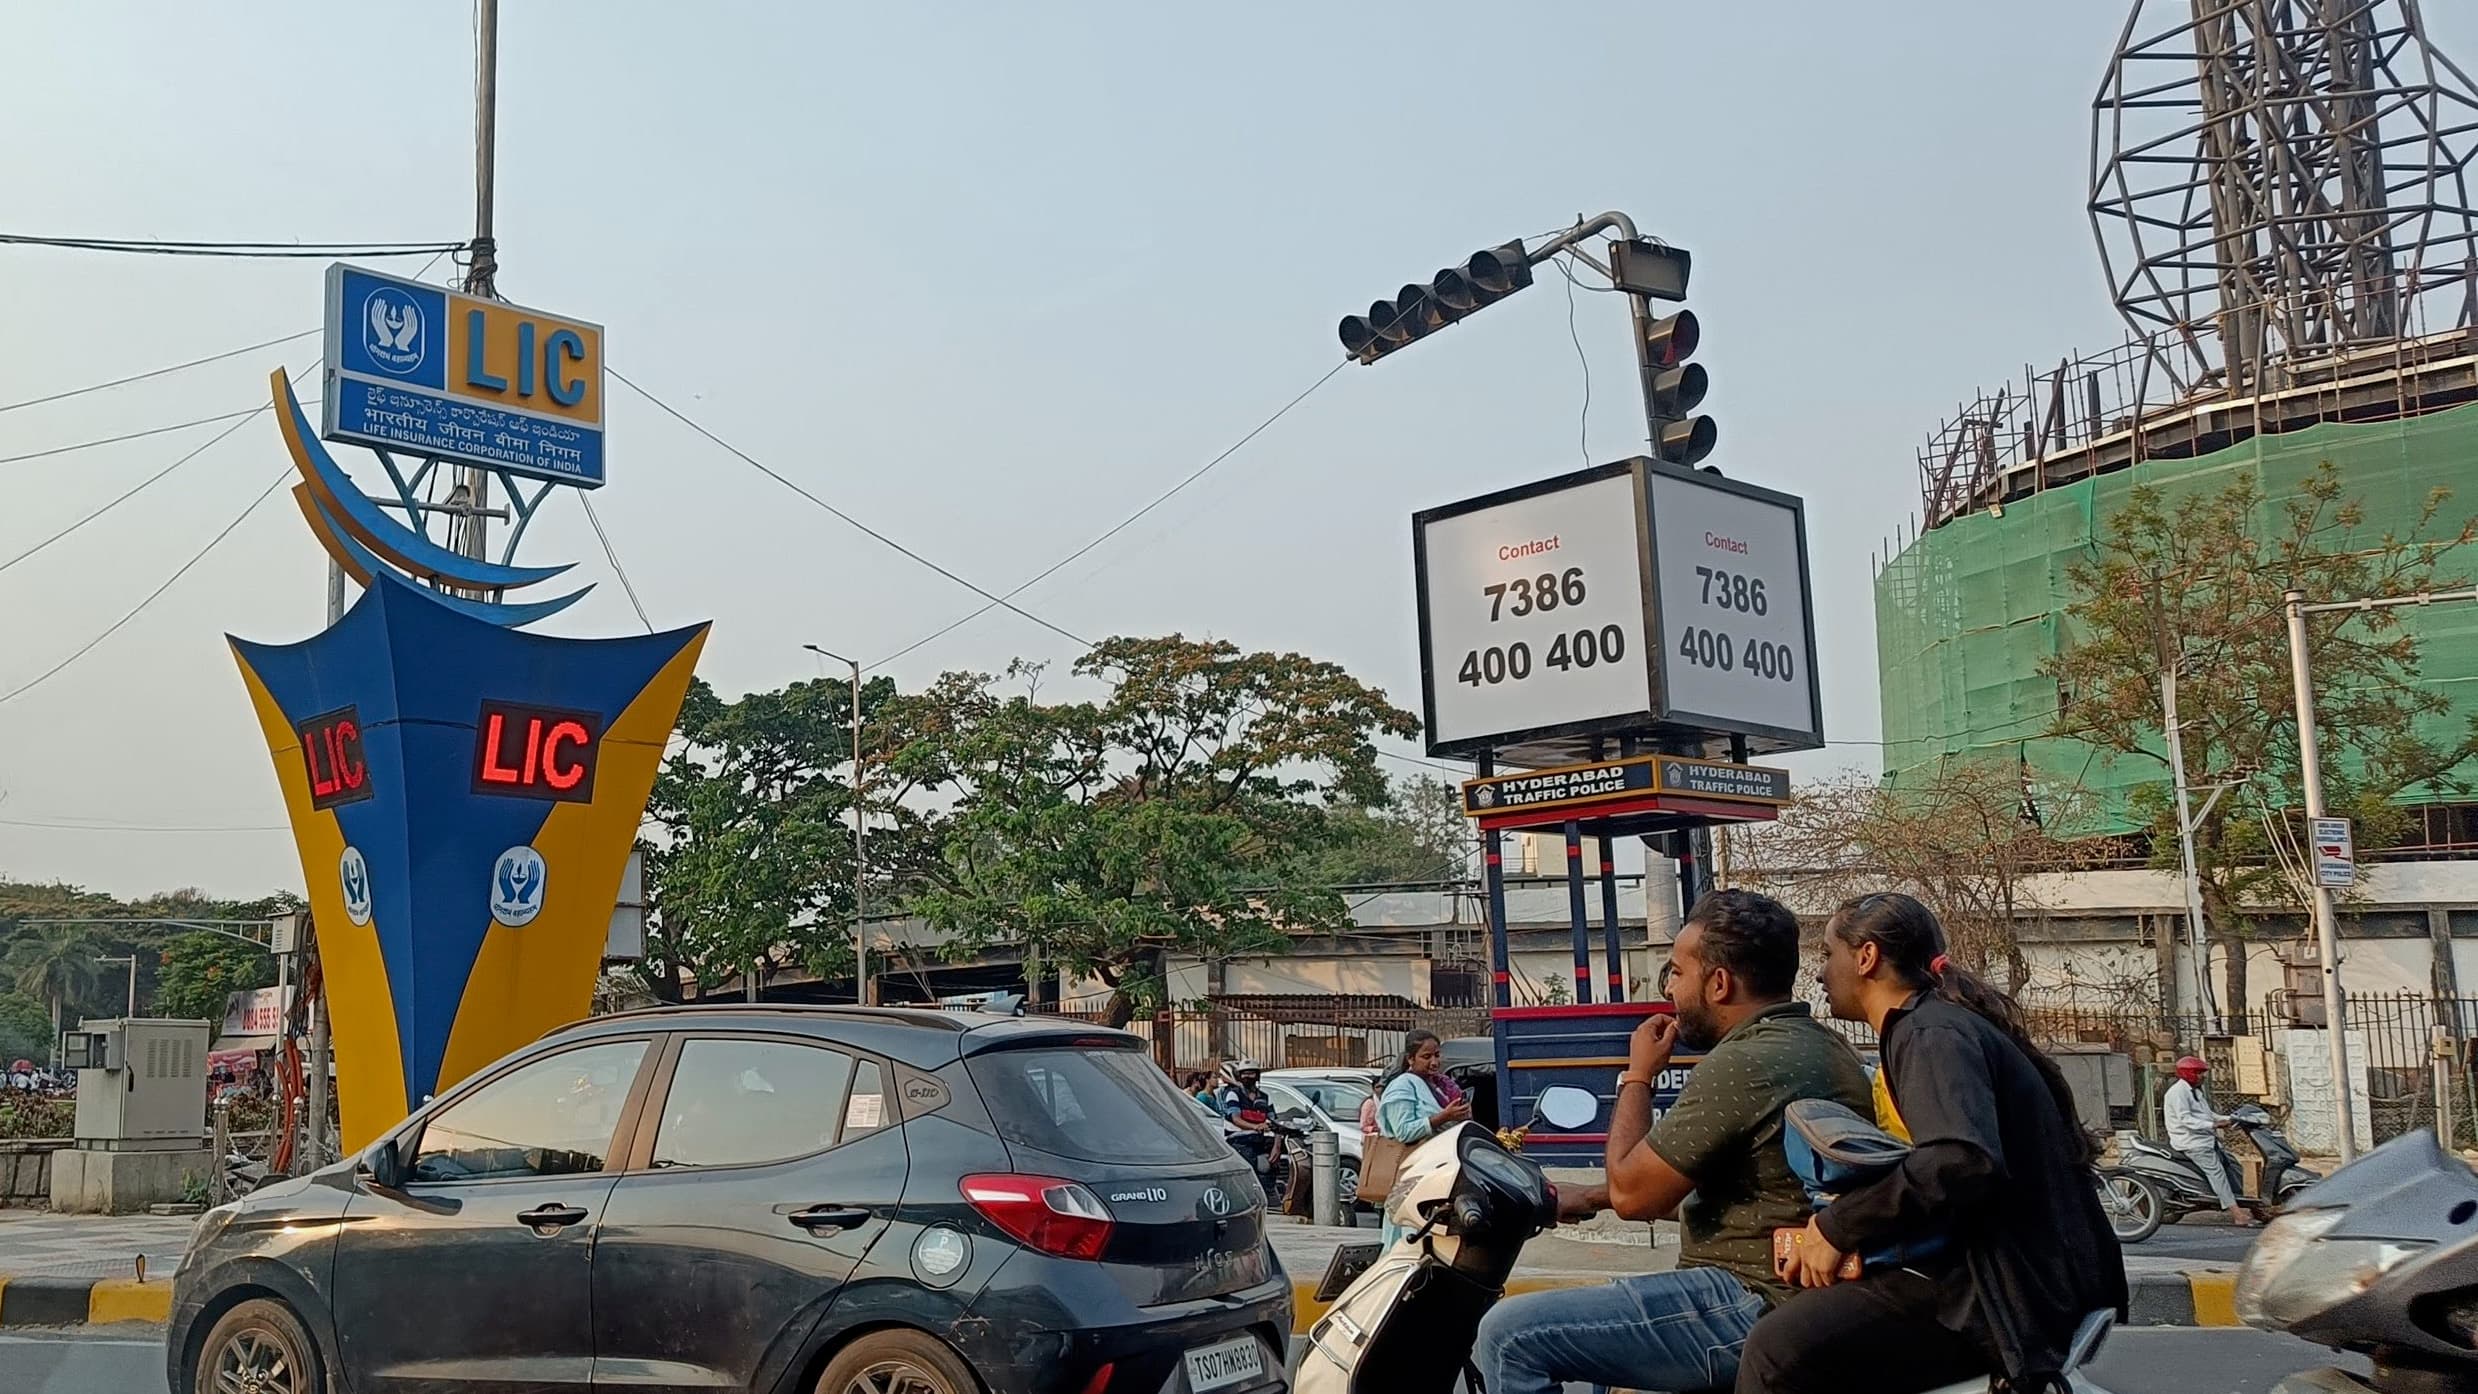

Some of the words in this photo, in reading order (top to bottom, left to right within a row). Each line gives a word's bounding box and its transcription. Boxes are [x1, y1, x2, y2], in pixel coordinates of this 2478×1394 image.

[466, 310, 586, 407] LIC
[363, 422, 388, 436] LIFE
[390, 427, 455, 449] INSURANCE
[458, 441, 534, 465] CORPORATION
[536, 456, 551, 468] OF
[553, 459, 582, 474] INDIA
[364, 408, 428, 432] भारतीय
[437, 421, 486, 443] जीवन
[538, 439, 582, 462] निगम
[1499, 535, 1560, 561] Contact
[1705, 531, 1748, 555] Contact
[1484, 567, 1586, 622] 7386
[1696, 565, 1767, 616] 7386
[1458, 641, 1532, 688] 400
[1546, 623, 1625, 672] 400
[1680, 626, 1733, 672] 400
[1743, 638, 1793, 682] 400
[305, 720, 365, 796] LIC
[482, 714, 588, 789] LIC
[1689, 765, 1771, 784] HYDERABAD
[1502, 766, 1625, 793] HYDERABAD
[1504, 788, 1566, 805] TRAFFIC
[1570, 779, 1625, 797] POLICE
[1690, 780, 1735, 794] TRAFFIC
[1736, 784, 1773, 797] POLICE
[1111, 1191, 1146, 1202] GRAND
